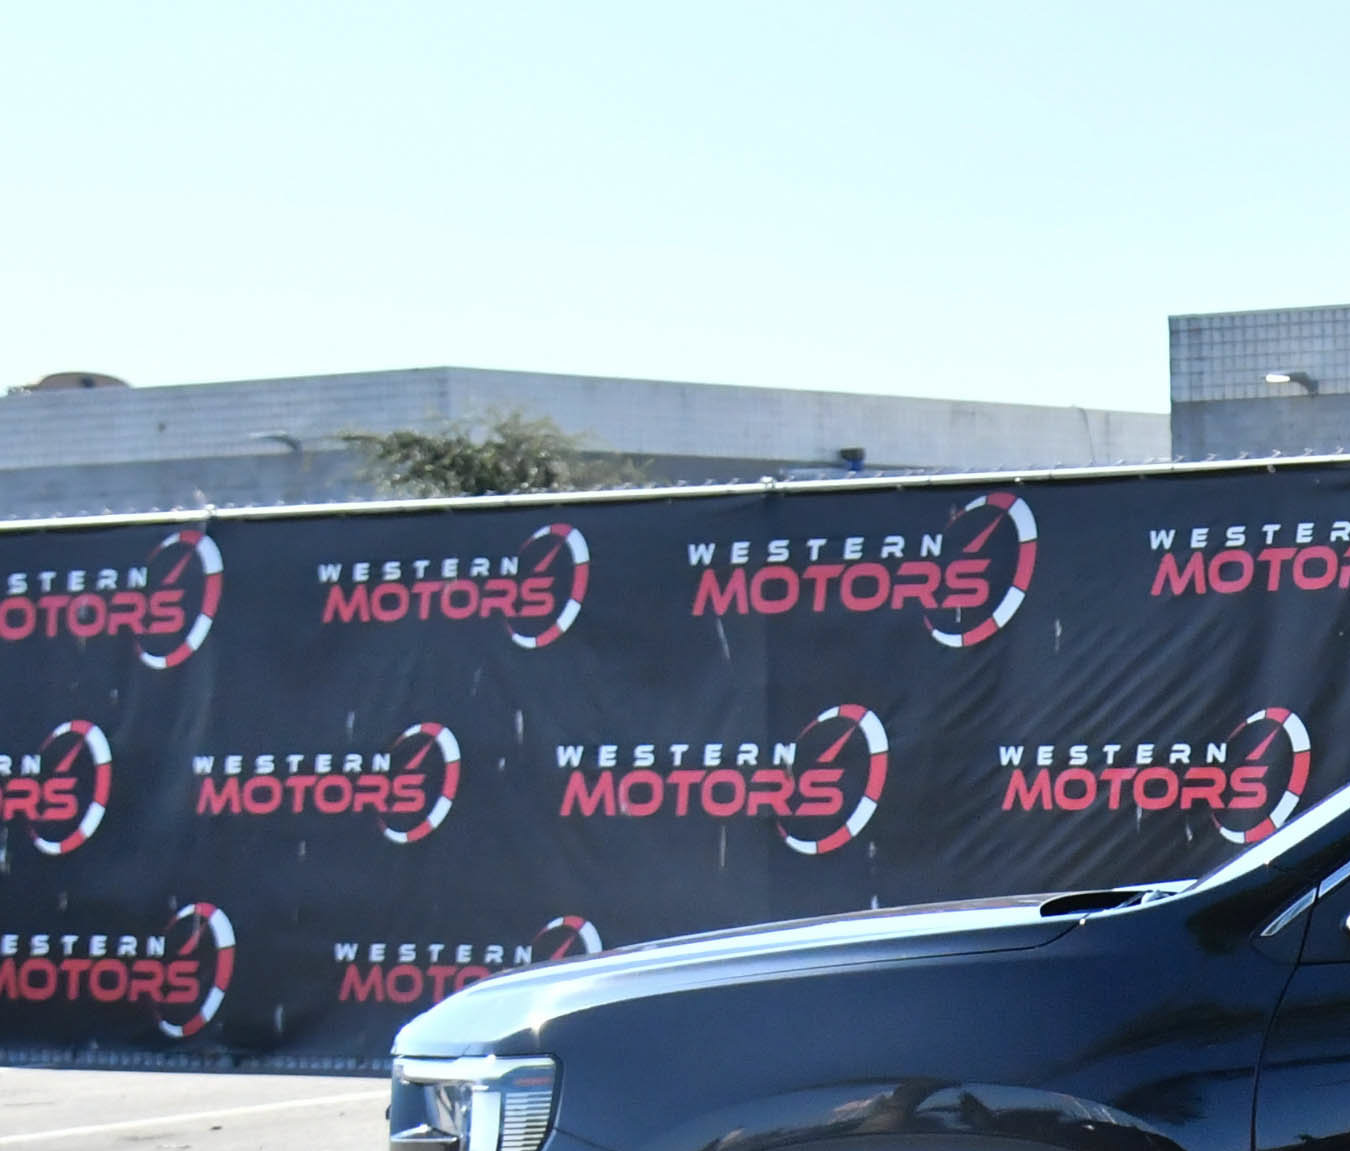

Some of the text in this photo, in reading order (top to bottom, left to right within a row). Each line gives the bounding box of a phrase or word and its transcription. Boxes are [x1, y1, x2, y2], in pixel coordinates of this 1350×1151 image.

[688, 534, 943, 566] WESTERN
[319, 556, 519, 583] WESTERN
[322, 577, 555, 623] MOTORS
[692, 559, 991, 617] MOTORS
[192, 753, 391, 775] WESTERN
[556, 742, 796, 769] WESTERN
[999, 742, 1227, 767] WESTERN
[197, 773, 426, 815] MOTORS
[559, 767, 844, 817] MOTORS
[1002, 765, 1269, 811] MOTORS
[334, 943, 533, 965] WESTERN
